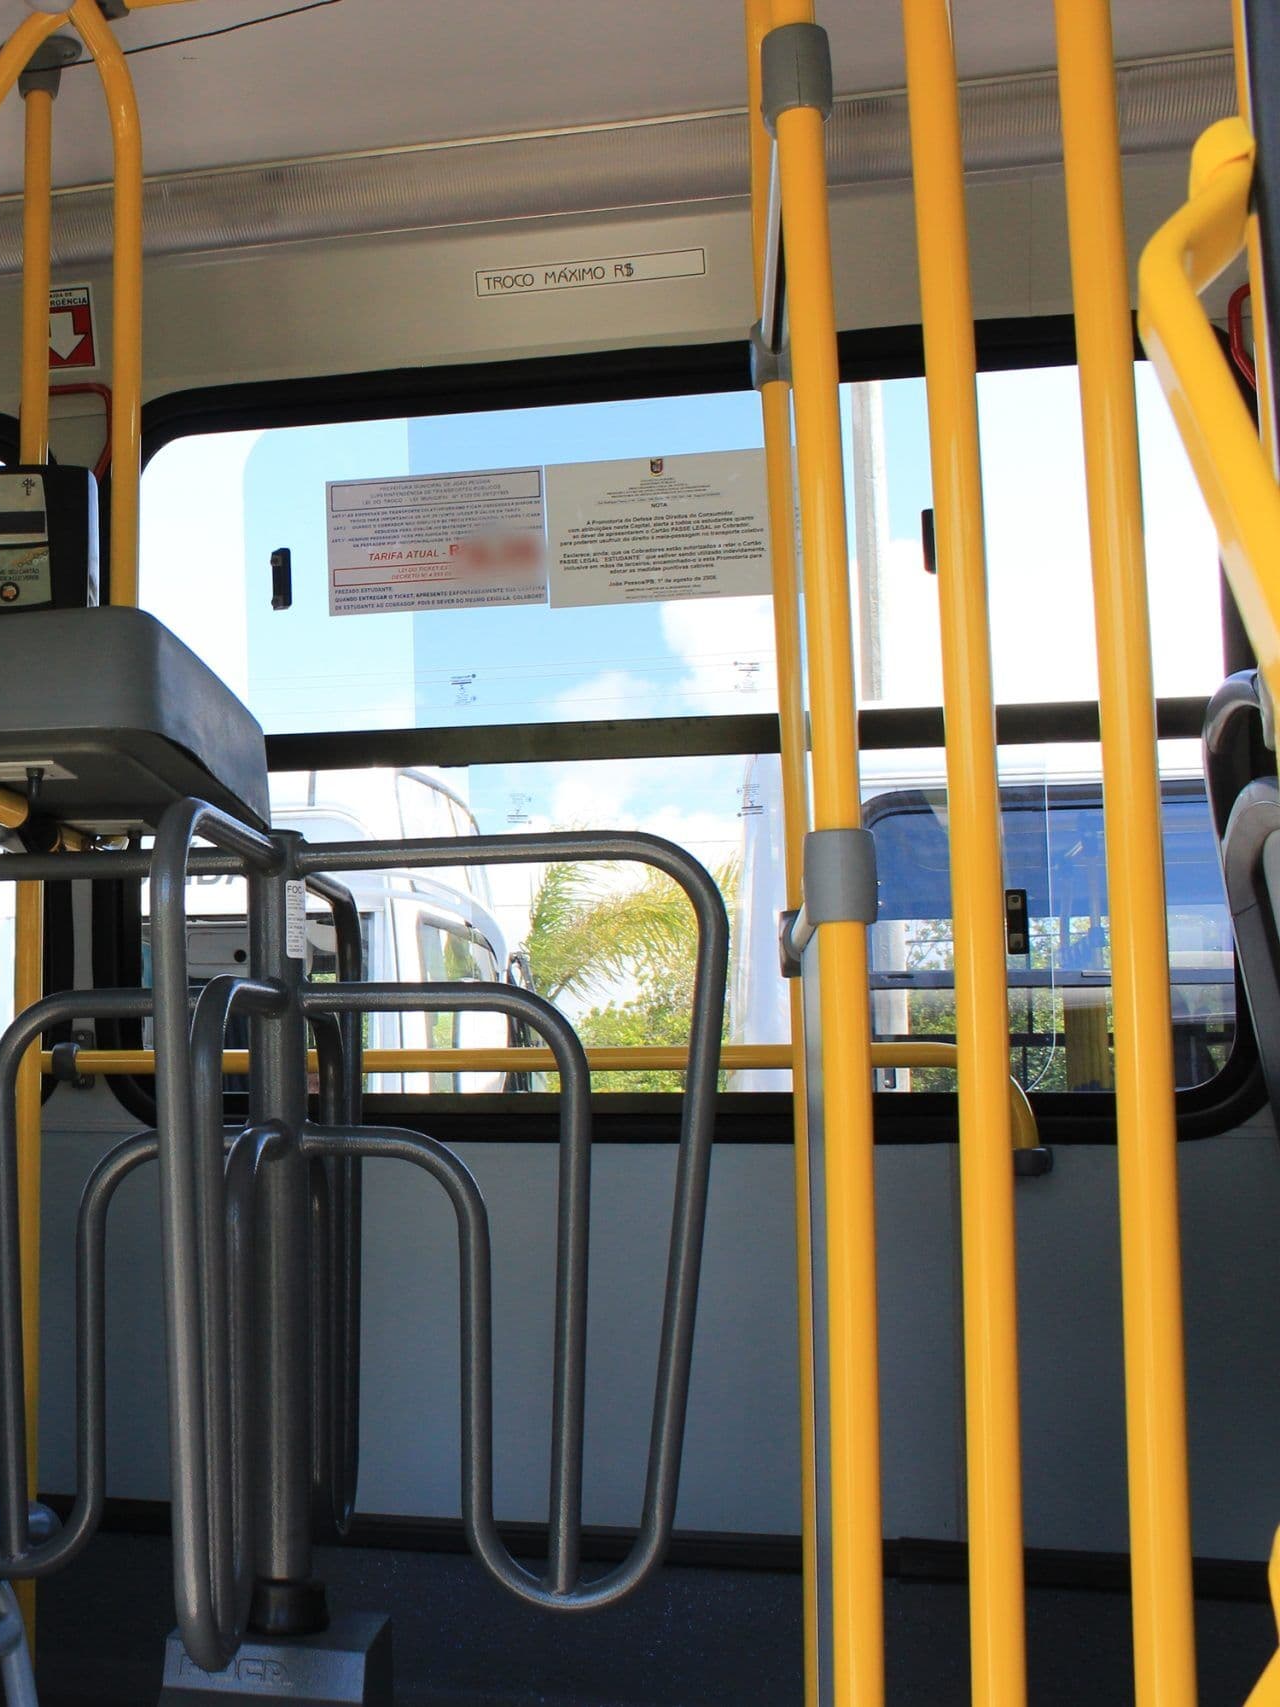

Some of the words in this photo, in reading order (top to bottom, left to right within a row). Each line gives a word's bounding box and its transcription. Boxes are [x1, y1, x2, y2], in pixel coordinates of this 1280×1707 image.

[484, 273, 534, 290] TROCO
[544, 265, 605, 285] MÁXIMO
[614, 262, 634, 278] R$
[49, 297, 87, 306] RGÊNCIA
[368, 551, 402, 561] TARIFA
[406, 548, 438, 558] ATUAL
[287, 885, 304, 894] FOC
